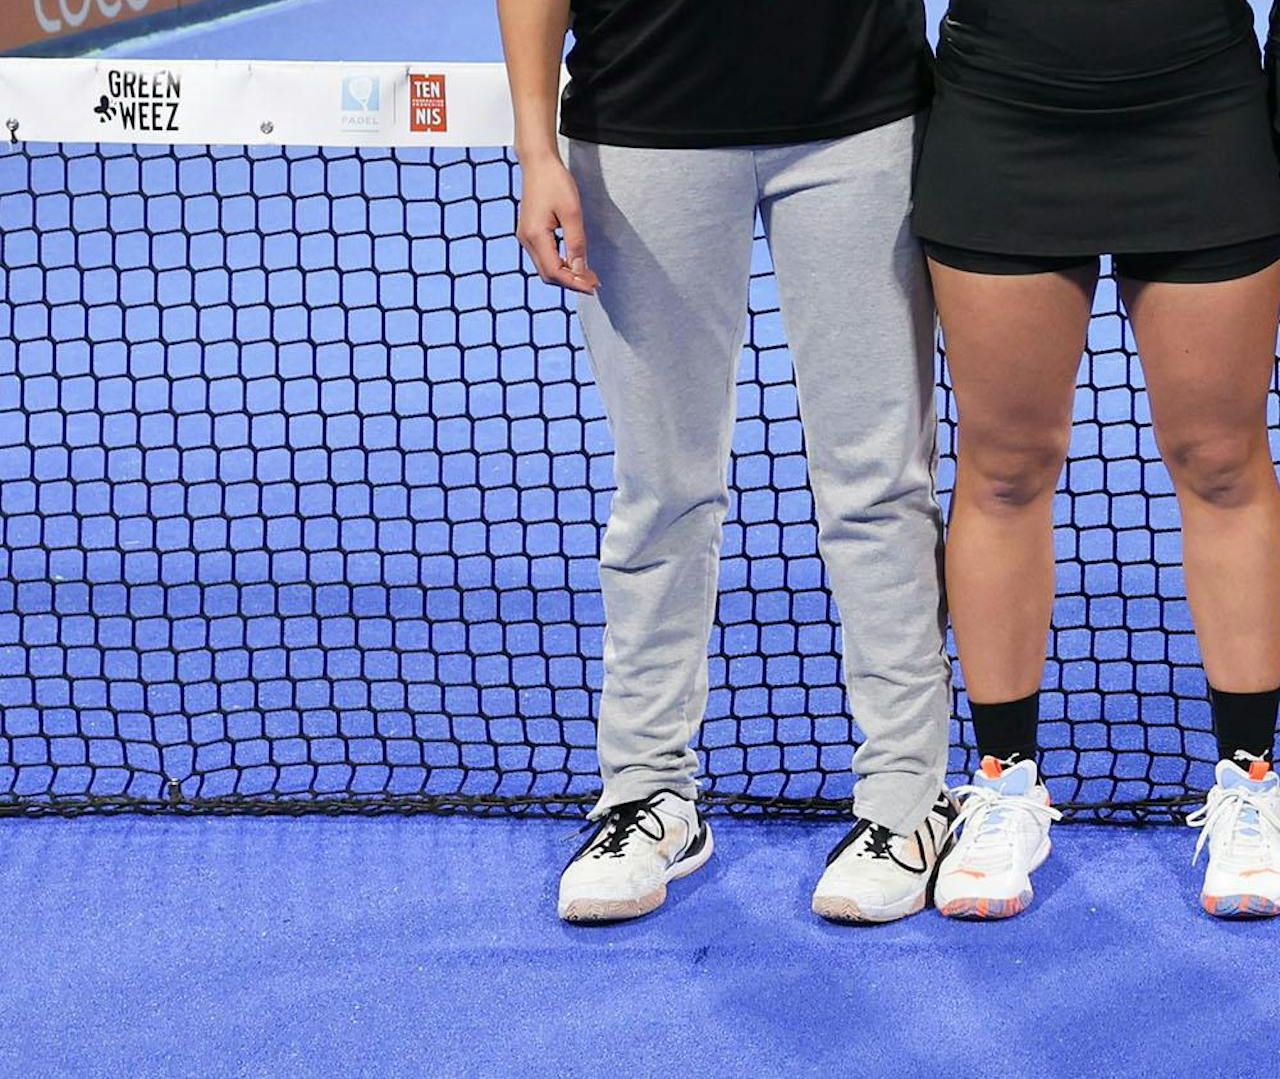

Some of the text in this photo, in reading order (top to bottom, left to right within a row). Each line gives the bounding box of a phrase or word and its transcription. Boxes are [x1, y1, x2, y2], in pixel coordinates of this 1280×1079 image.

[108, 70, 181, 98] GREEN
[414, 81, 440, 98] TEN
[119, 102, 179, 131] WEEZ
[416, 108, 442, 125] NIS
